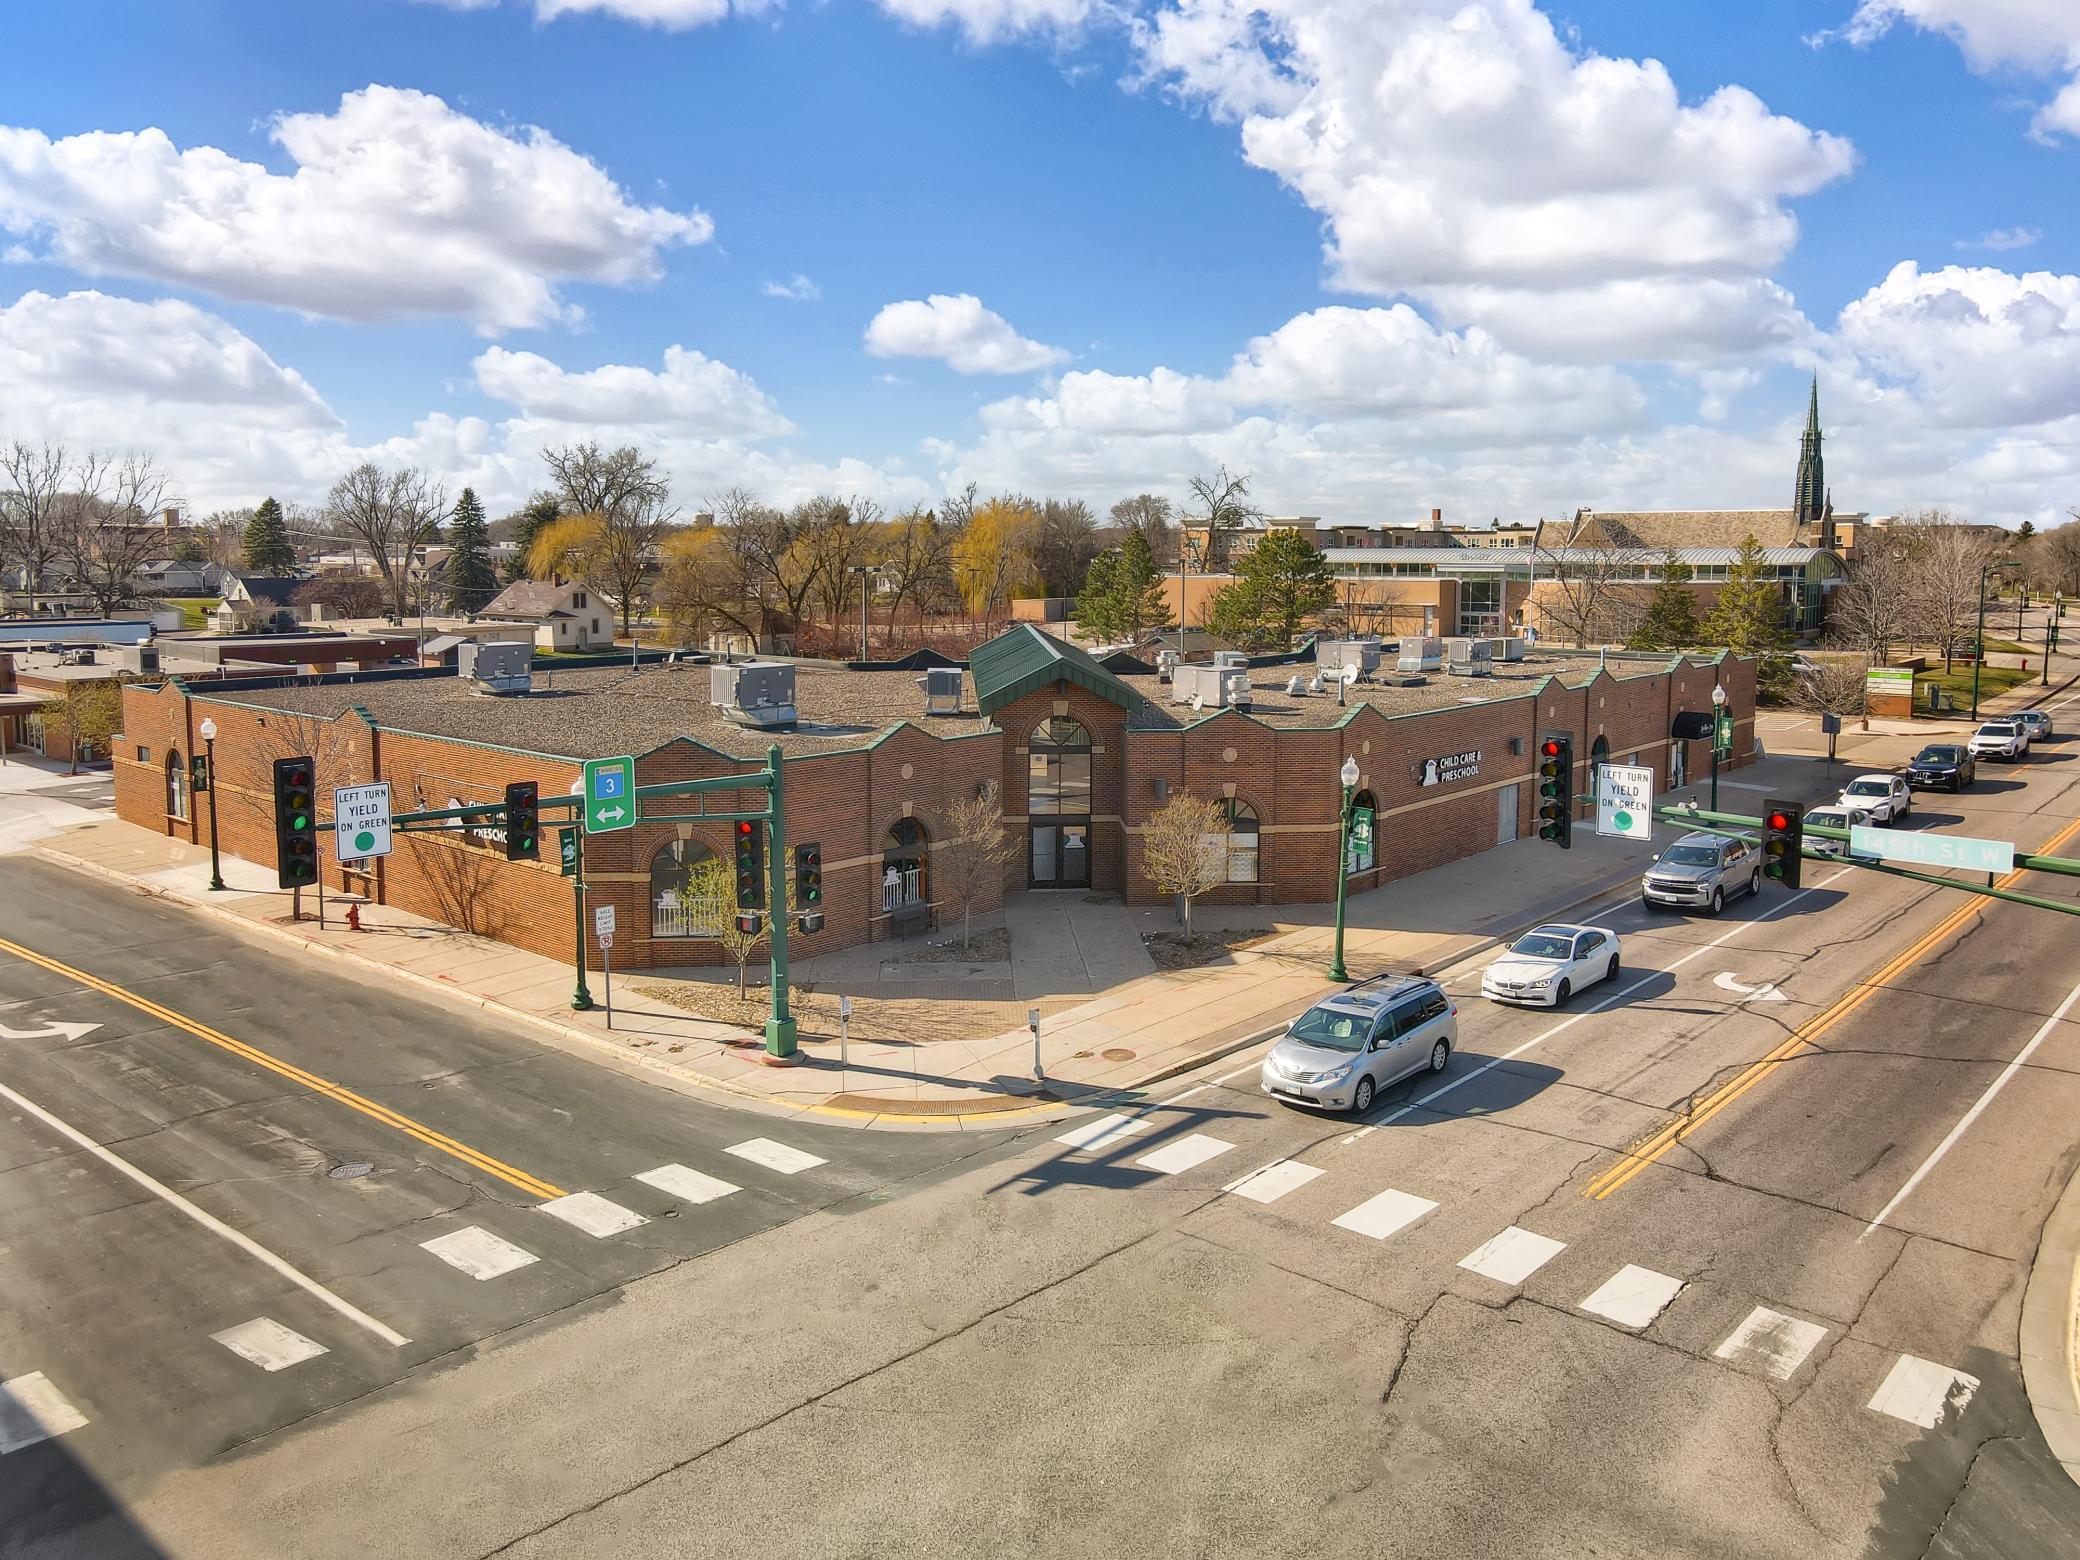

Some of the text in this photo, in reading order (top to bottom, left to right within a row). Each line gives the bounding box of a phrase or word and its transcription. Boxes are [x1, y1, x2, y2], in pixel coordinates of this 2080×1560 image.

[1440, 750, 1482, 769] CHILD CARE &
[1441, 765, 1479, 783] PRESCHOOL
[1602, 770, 1649, 782] LEFT TURN
[606, 778, 615, 794] 3
[1611, 784, 1640, 797] YIELD
[339, 789, 386, 803] LEFT TURN
[349, 803, 378, 816] YIELD
[1602, 798, 1647, 811] ON GREEN
[340, 817, 387, 832] ON GREEN
[1938, 841, 1967, 861] St
[1981, 846, 2001, 864] W
